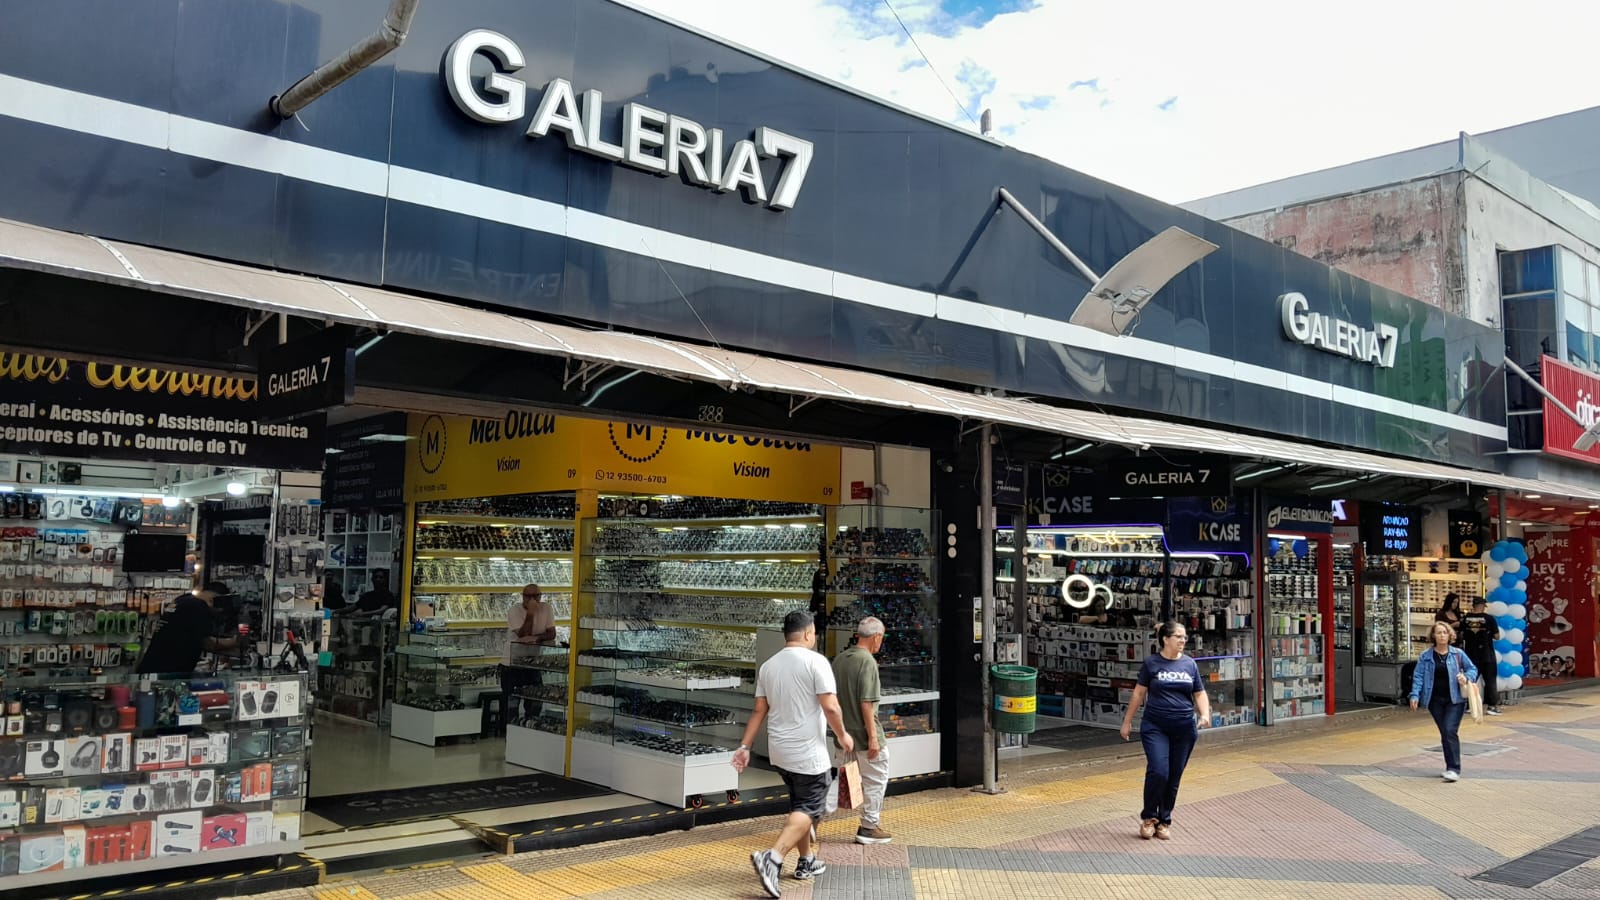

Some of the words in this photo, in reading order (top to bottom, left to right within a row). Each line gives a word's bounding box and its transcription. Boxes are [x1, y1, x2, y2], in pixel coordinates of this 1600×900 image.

[268, 365, 318, 397] GALERIA
[321, 356, 331, 382] 7
[50, 404, 146, 427] Acessórios
[157, 413, 248, 435] Assistência
[77, 429, 99, 446] de
[102, 431, 122, 448] Tv
[134, 433, 204, 452] Controle
[206, 438, 226, 454] de
[229, 439, 247, 456] Tv
[497, 456, 521, 472] Vision
[733, 461, 770, 479] Vision
[606, 471, 615, 480] 12
[618, 472, 667, 484] 93500-6703
[1125, 472, 1195, 485] GALERIA
[1198, 469, 1211, 483] 7
[1533, 563, 1565, 575] LEVE
[1544, 576, 1556, 592] 3
[1158, 671, 1193, 681] HOYA
